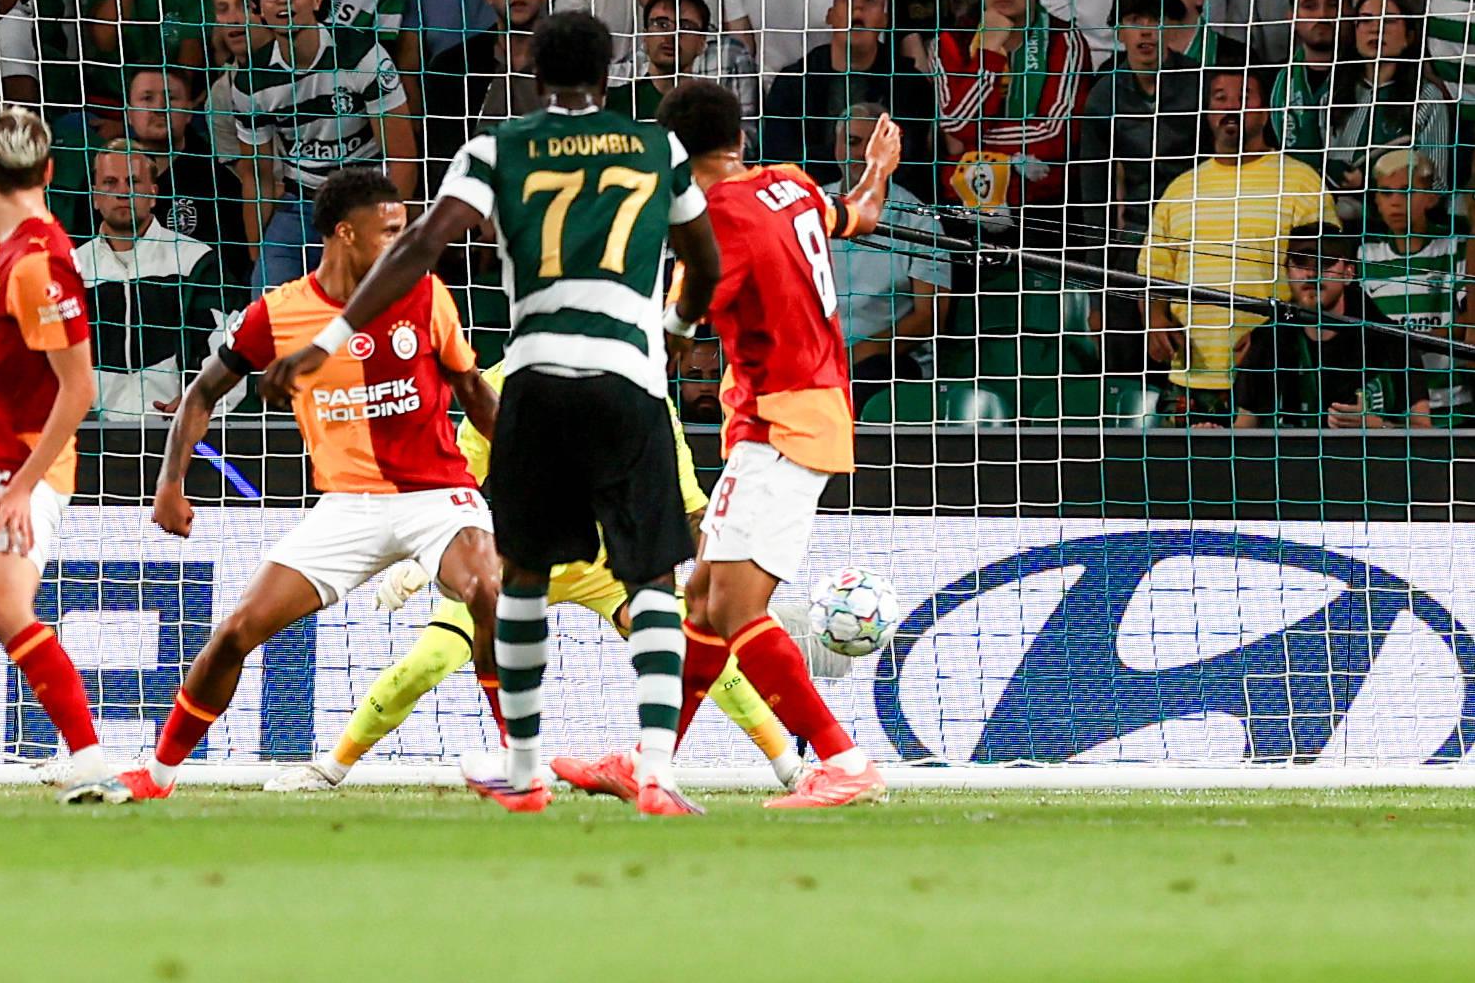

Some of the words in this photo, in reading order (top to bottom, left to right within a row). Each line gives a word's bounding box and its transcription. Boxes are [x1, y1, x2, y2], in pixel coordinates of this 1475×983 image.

[290, 136, 362, 161] Betano
[528, 139, 541, 158] I.
[548, 131, 646, 158] DOUMBIA
[521, 166, 659, 279] 77
[794, 213, 837, 320] 8
[450, 491, 477, 508] 4
[715, 477, 736, 517] 8
